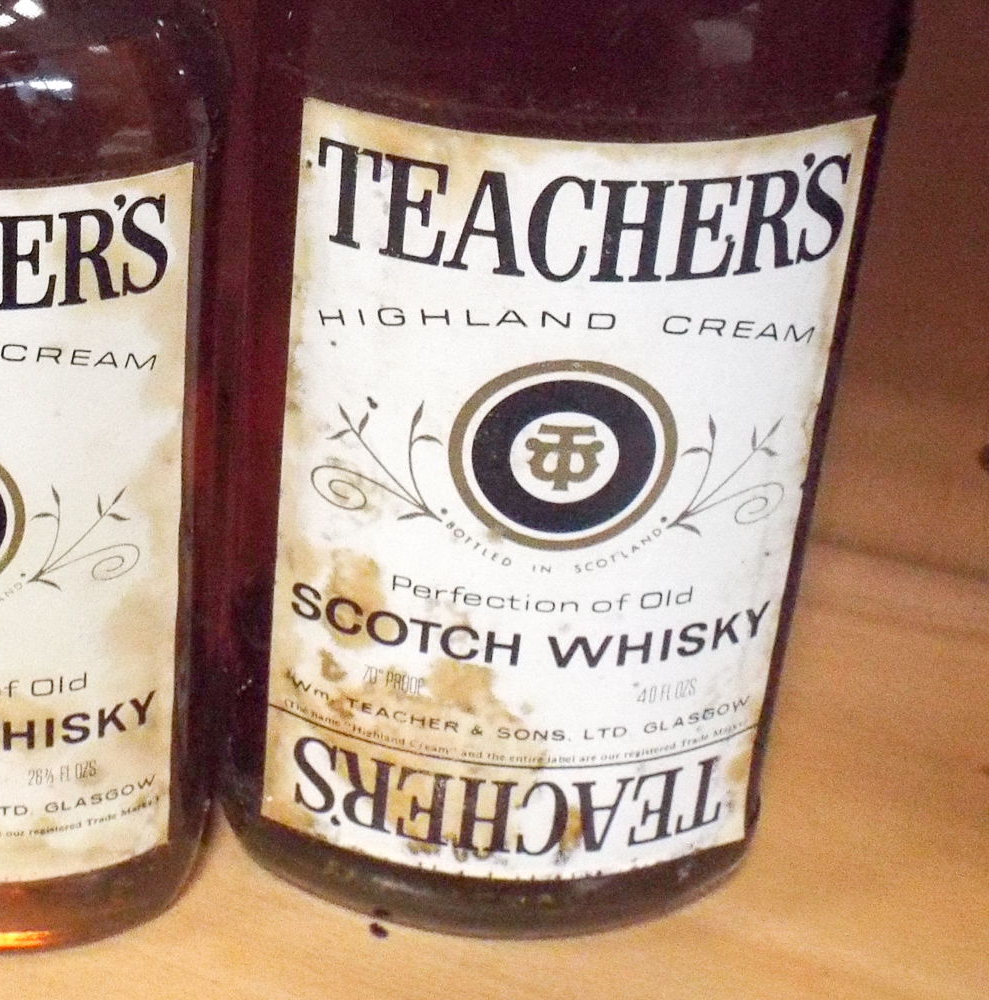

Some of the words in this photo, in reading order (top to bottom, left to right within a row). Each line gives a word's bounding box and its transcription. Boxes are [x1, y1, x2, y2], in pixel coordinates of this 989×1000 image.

[318, 136, 852, 283] TEACHER'S
[318, 306, 616, 330] HIGHLAND
[661, 315, 816, 345] CREAM
[0, 343, 158, 371] CREAM
[446, 521, 512, 567] BOTTLED
[531, 564, 551, 574] IN
[574, 527, 662, 574] SCOTLAND
[392, 574, 578, 614] Perfection
[591, 590, 632, 613] of
[639, 586, 693, 609] Old
[291, 581, 522, 666] SCOTCH
[548, 600, 771, 669] WHISKY
[30, 672, 88, 697] Old
[347, 697, 459, 732] TEACHER
[470, 725, 484, 736] &
[497, 726, 572, 742] SONS.
[583, 725, 628, 740] LTD
[643, 694, 752, 734] GLASGOW
[44, 773, 156, 814] GLASGOW
[293, 735, 723, 856] TEACHER'S
